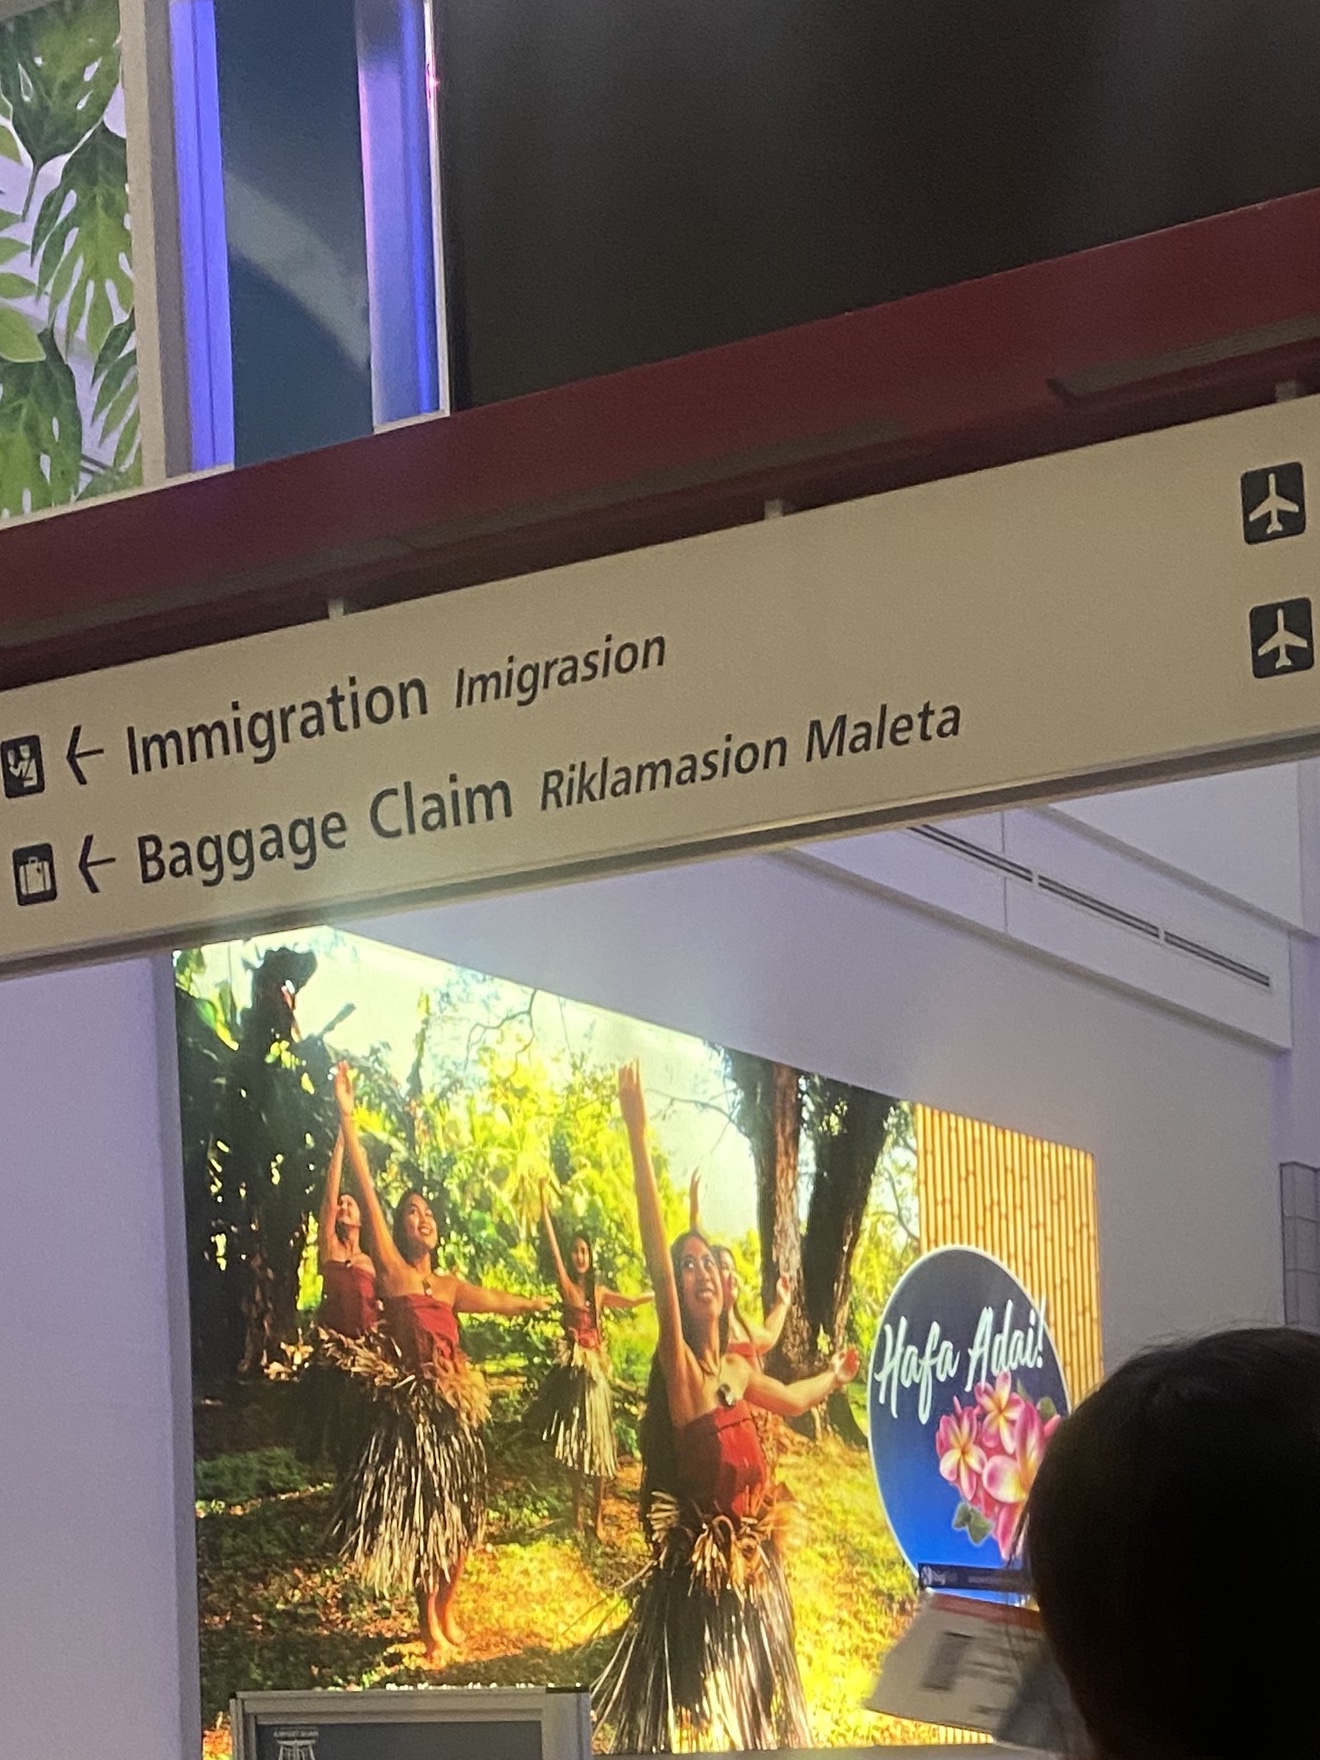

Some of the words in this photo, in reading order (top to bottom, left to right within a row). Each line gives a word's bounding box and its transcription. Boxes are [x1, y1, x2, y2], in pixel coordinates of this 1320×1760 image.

[125, 674, 430, 777] Immigration
[454, 632, 667, 710] Imigrasion
[136, 810, 349, 889] Baggage
[368, 771, 514, 840] Claim
[539, 732, 789, 813] Riklamasion
[804, 699, 962, 764] Maleta
[873, 1315, 960, 1425] Hafa
[964, 1294, 1046, 1392] Adai!
